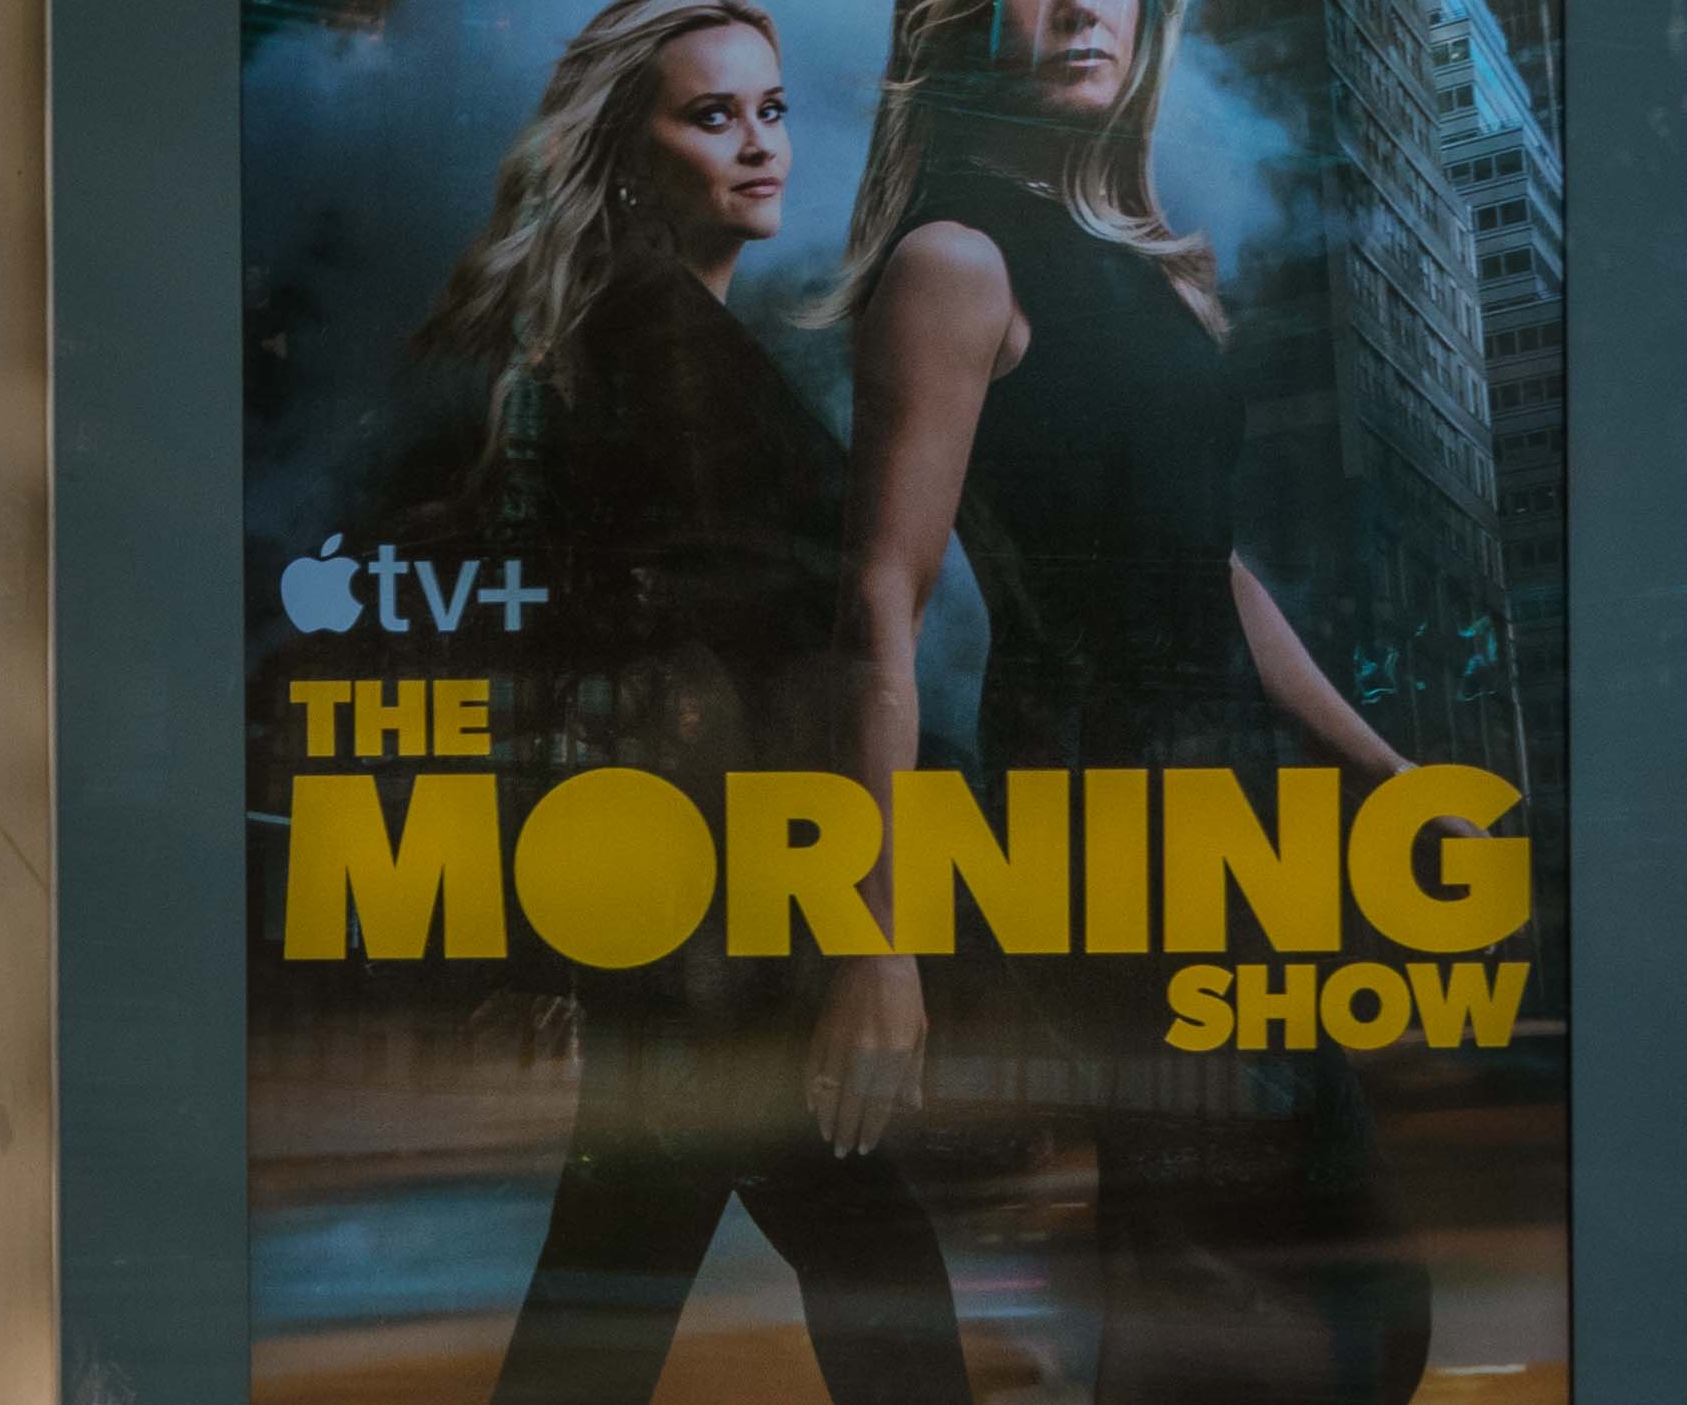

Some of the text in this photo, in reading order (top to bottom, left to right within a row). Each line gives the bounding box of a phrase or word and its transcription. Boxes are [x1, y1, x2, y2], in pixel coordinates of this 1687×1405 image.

[368, 544, 549, 633] tv+
[289, 679, 491, 757] THE
[284, 763, 1531, 969] MORNING
[1165, 961, 1530, 1051] SHOW
